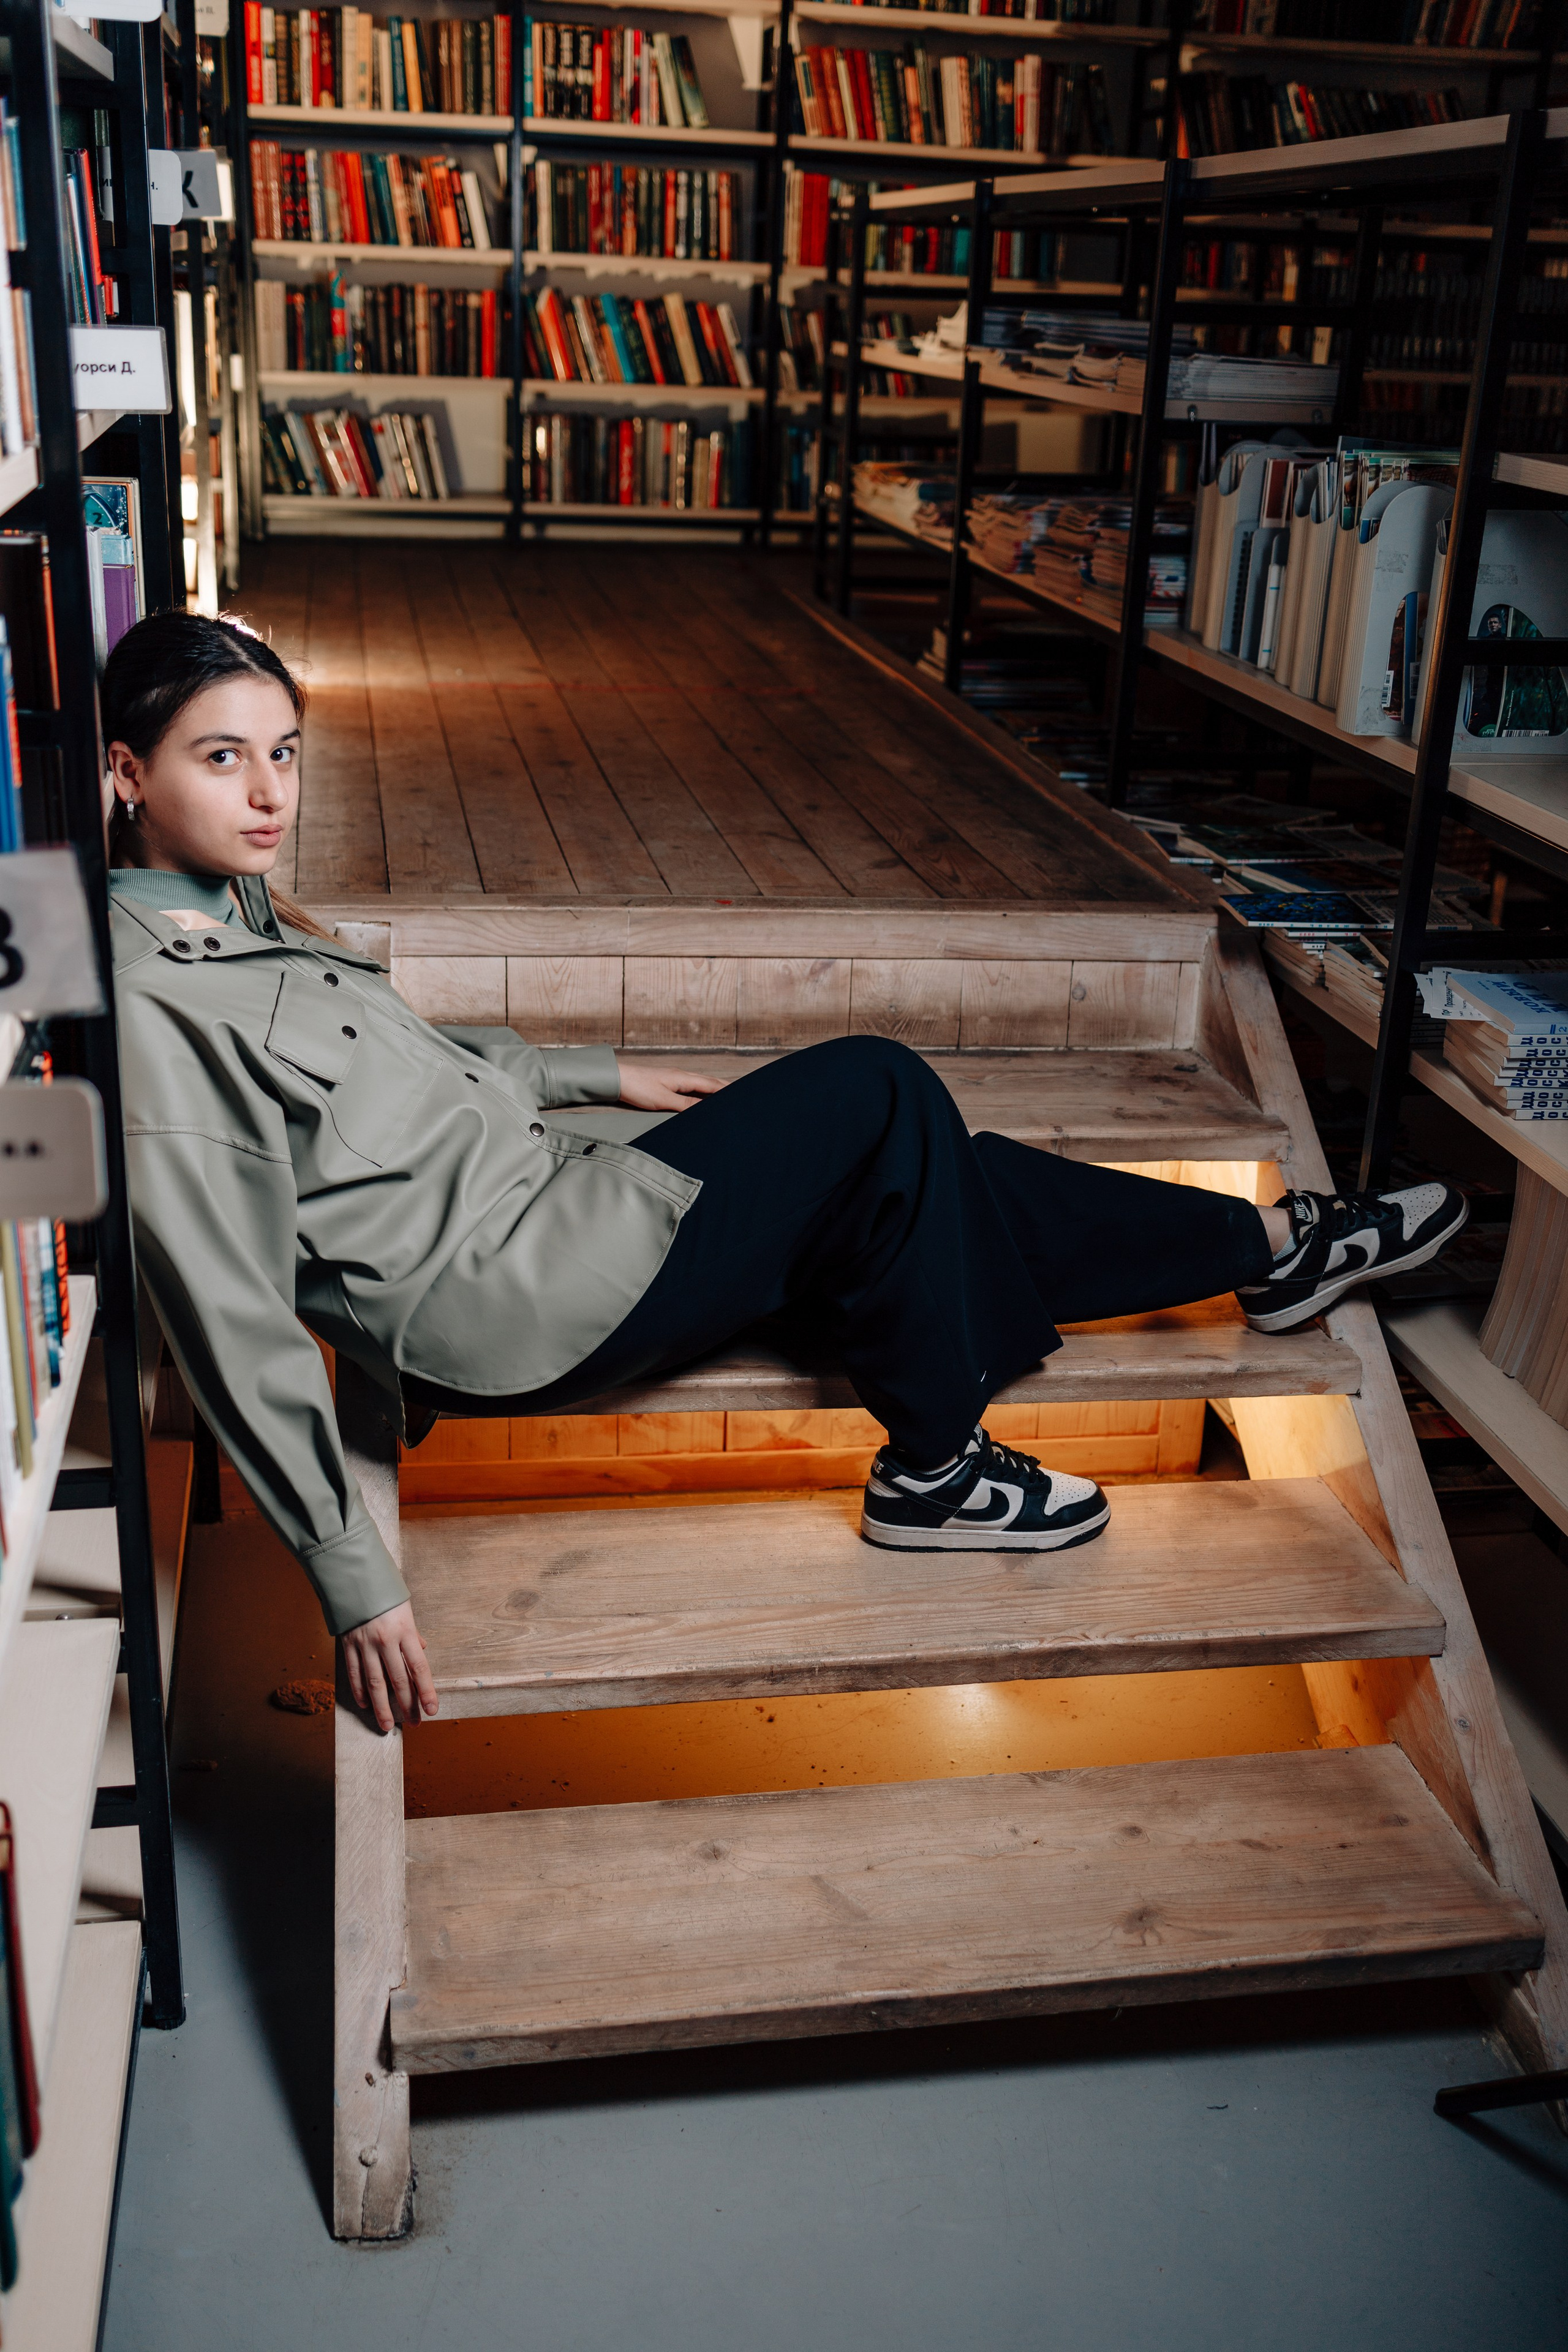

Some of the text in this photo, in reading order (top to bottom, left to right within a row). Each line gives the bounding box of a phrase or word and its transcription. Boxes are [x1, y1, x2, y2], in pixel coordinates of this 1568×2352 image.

[121, 361, 136, 375] Д.
[1487, 980, 1551, 1014] НОВЫЙ
[1294, 1203, 1306, 1219] NIKE
